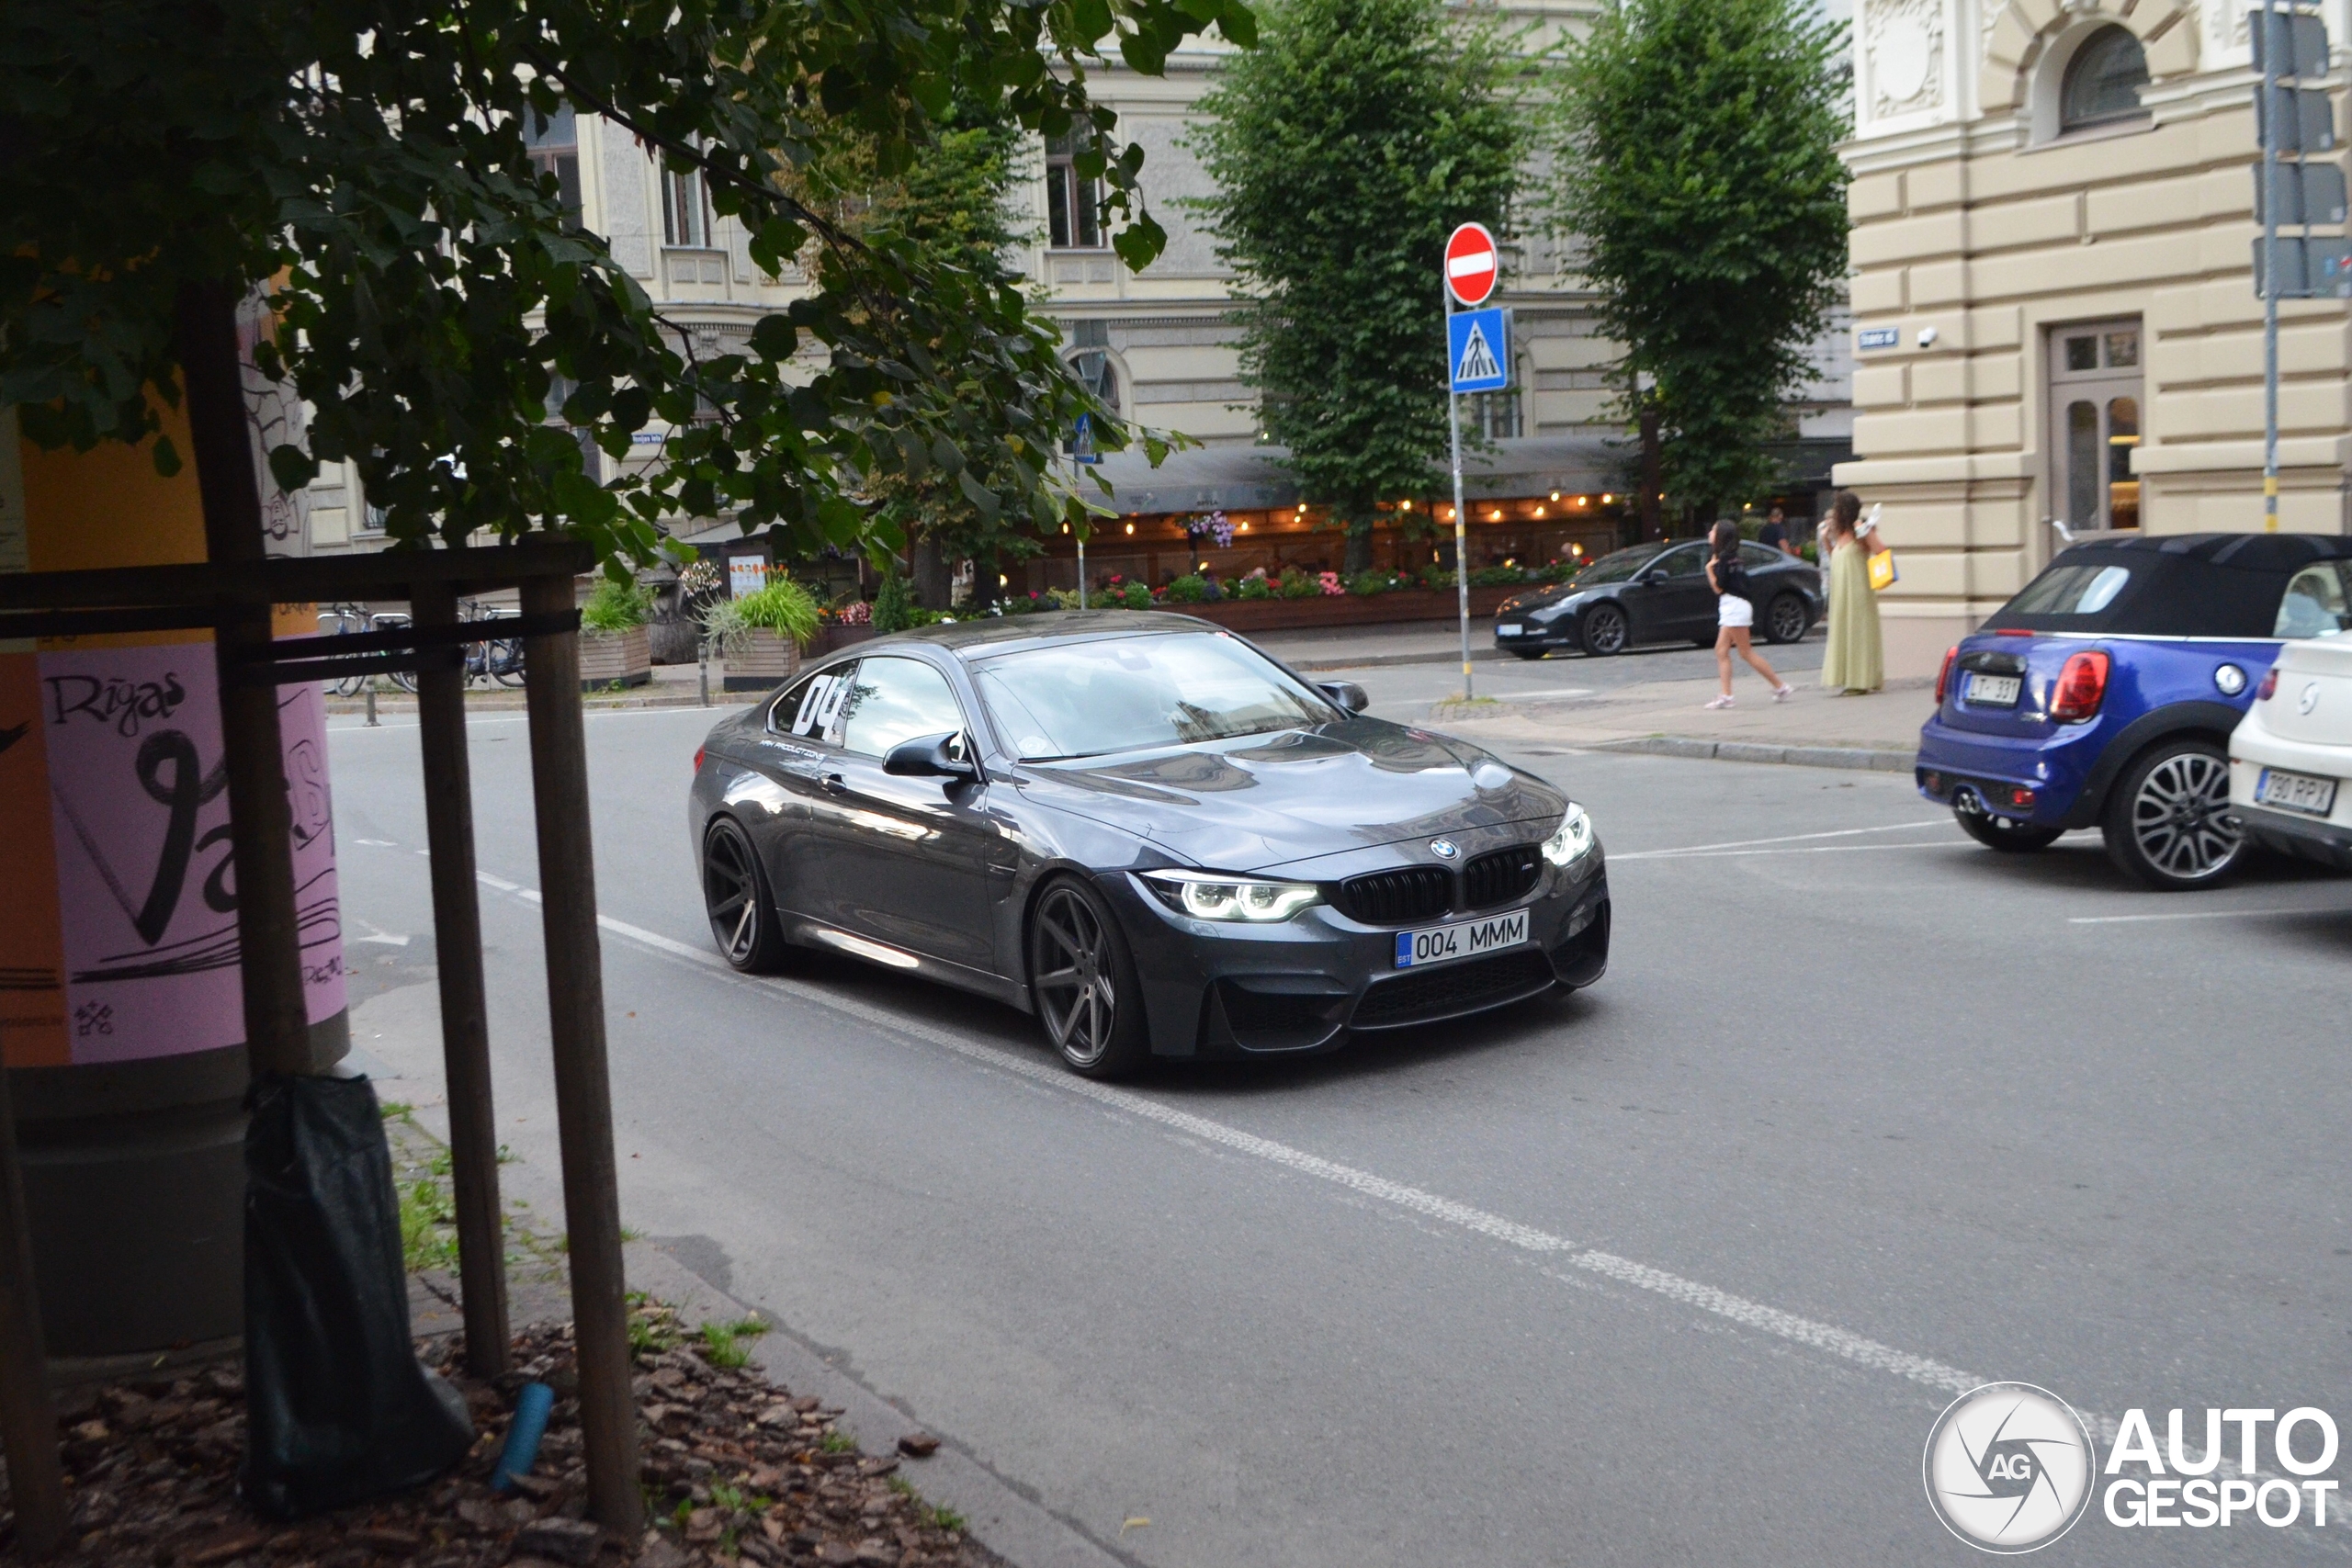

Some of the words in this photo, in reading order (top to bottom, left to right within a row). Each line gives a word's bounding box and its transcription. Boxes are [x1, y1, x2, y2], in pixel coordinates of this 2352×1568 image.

[43, 671, 184, 738] Rīgas
[791, 674, 847, 741] 04
[775, 742, 826, 761] PRODUCTIONS
[1397, 953, 1411, 964] EST
[1417, 930, 1457, 959] 004
[1470, 915, 1523, 951] MMM
